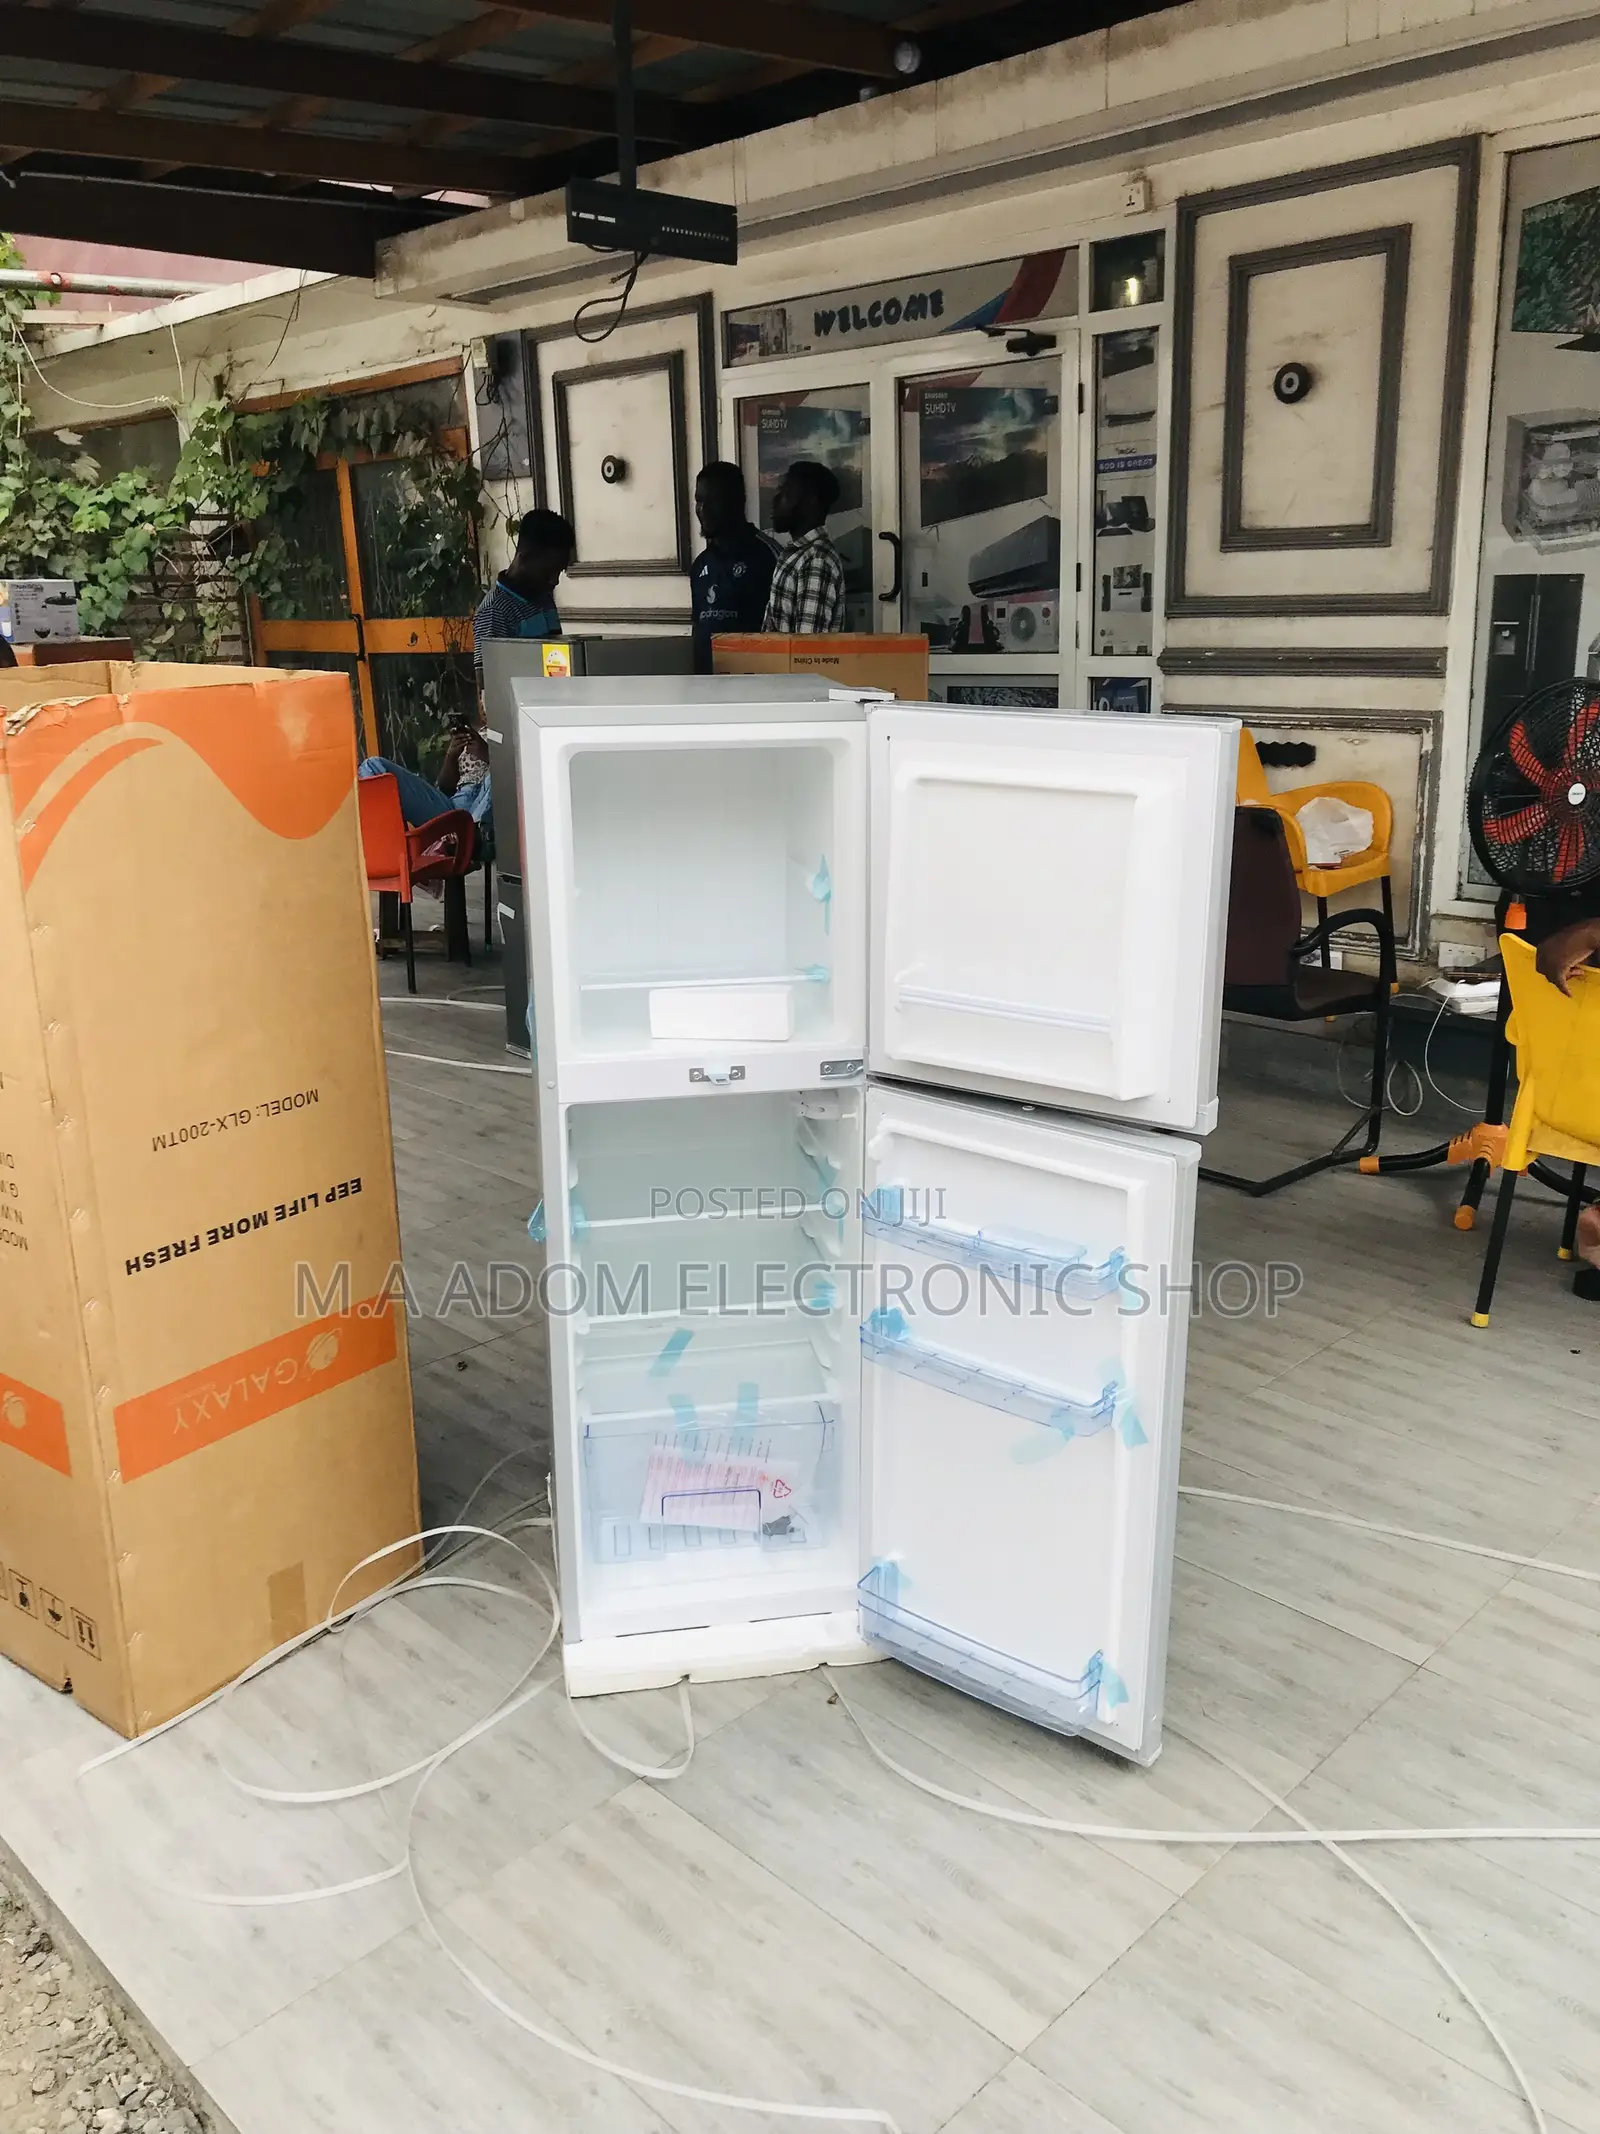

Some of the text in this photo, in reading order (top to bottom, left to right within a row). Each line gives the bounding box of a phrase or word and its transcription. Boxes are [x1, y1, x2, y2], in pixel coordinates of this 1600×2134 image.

[813, 288, 945, 338] WELCOME
[793, 657, 813, 665] China
[821, 657, 840, 665] Made
[152, 1088, 319, 1152] MODEL: GLX-200TM
[125, 1177, 363, 1276] EEP LIFE MORE FRESH
[172, 1357, 299, 1435] GALAXY
